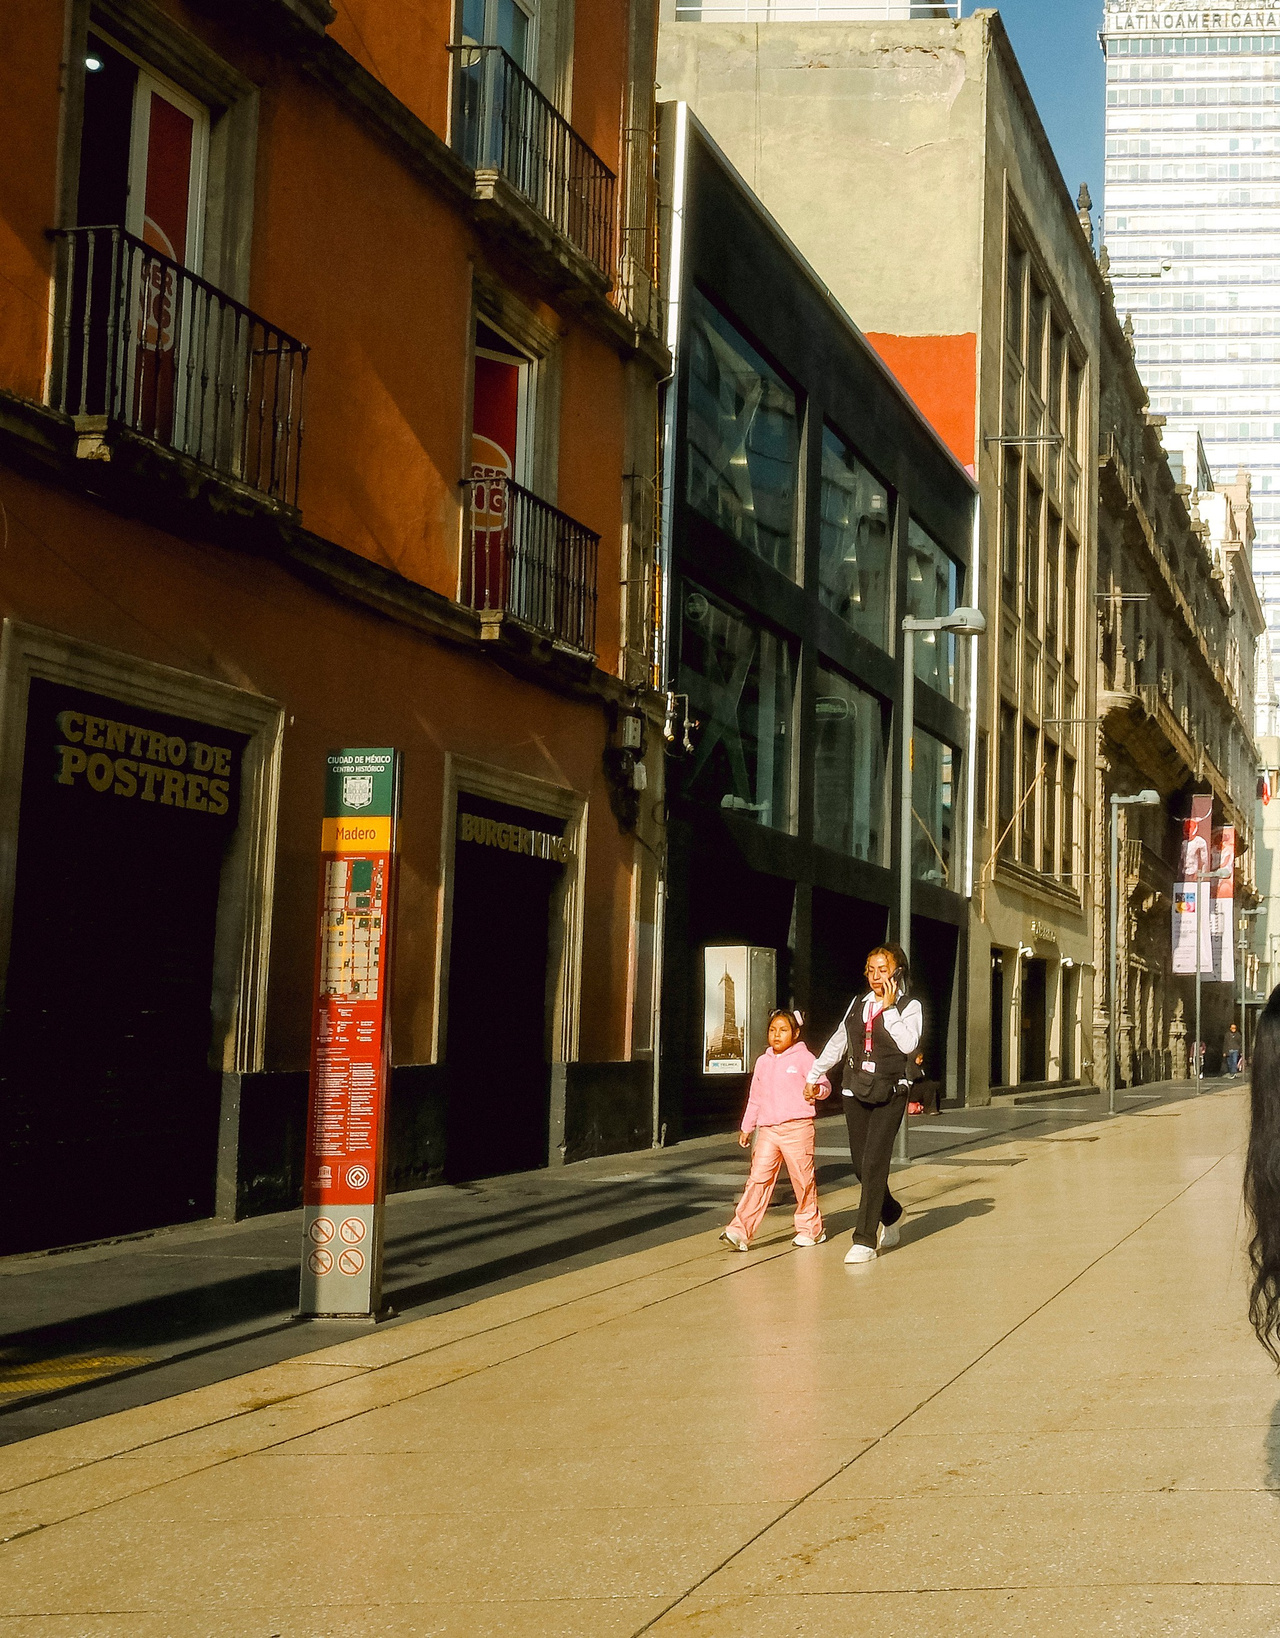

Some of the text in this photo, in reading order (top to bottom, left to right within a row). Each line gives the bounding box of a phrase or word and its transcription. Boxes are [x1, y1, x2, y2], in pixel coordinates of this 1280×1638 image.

[1115, 12, 1277, 30] LATINOAMERICANA
[58, 711, 232, 776] CENTRO DE
[327, 754, 391, 764] CIUDAD DE MÉXICO
[332, 764, 385, 773] CENTRO HISTÓRICO
[58, 745, 230, 815] POSTRES
[336, 827, 376, 840] Madero
[461, 812, 530, 854] BURGER
